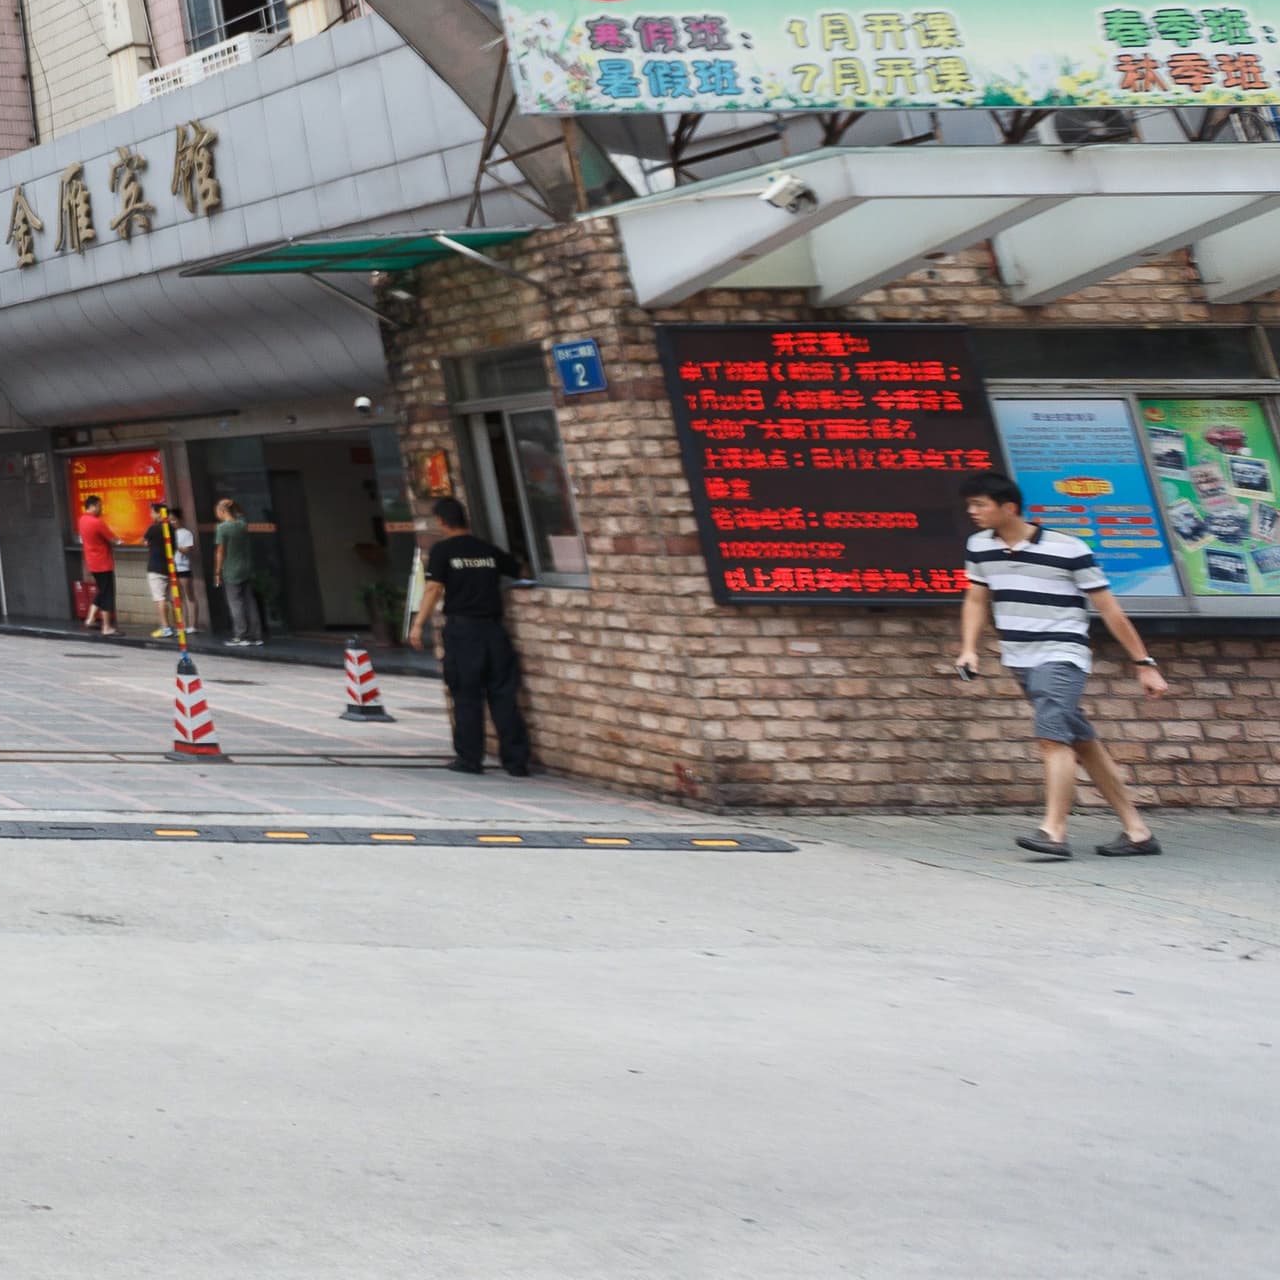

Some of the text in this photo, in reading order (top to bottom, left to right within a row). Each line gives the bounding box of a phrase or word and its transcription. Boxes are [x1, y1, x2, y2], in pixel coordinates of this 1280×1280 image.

[787, 12, 963, 51] 1月开课
[1102, 8, 1276, 48] 春季班：
[596, 57, 974, 99] 暑假班： 7月开课
[574, 363, 589, 387] 2
